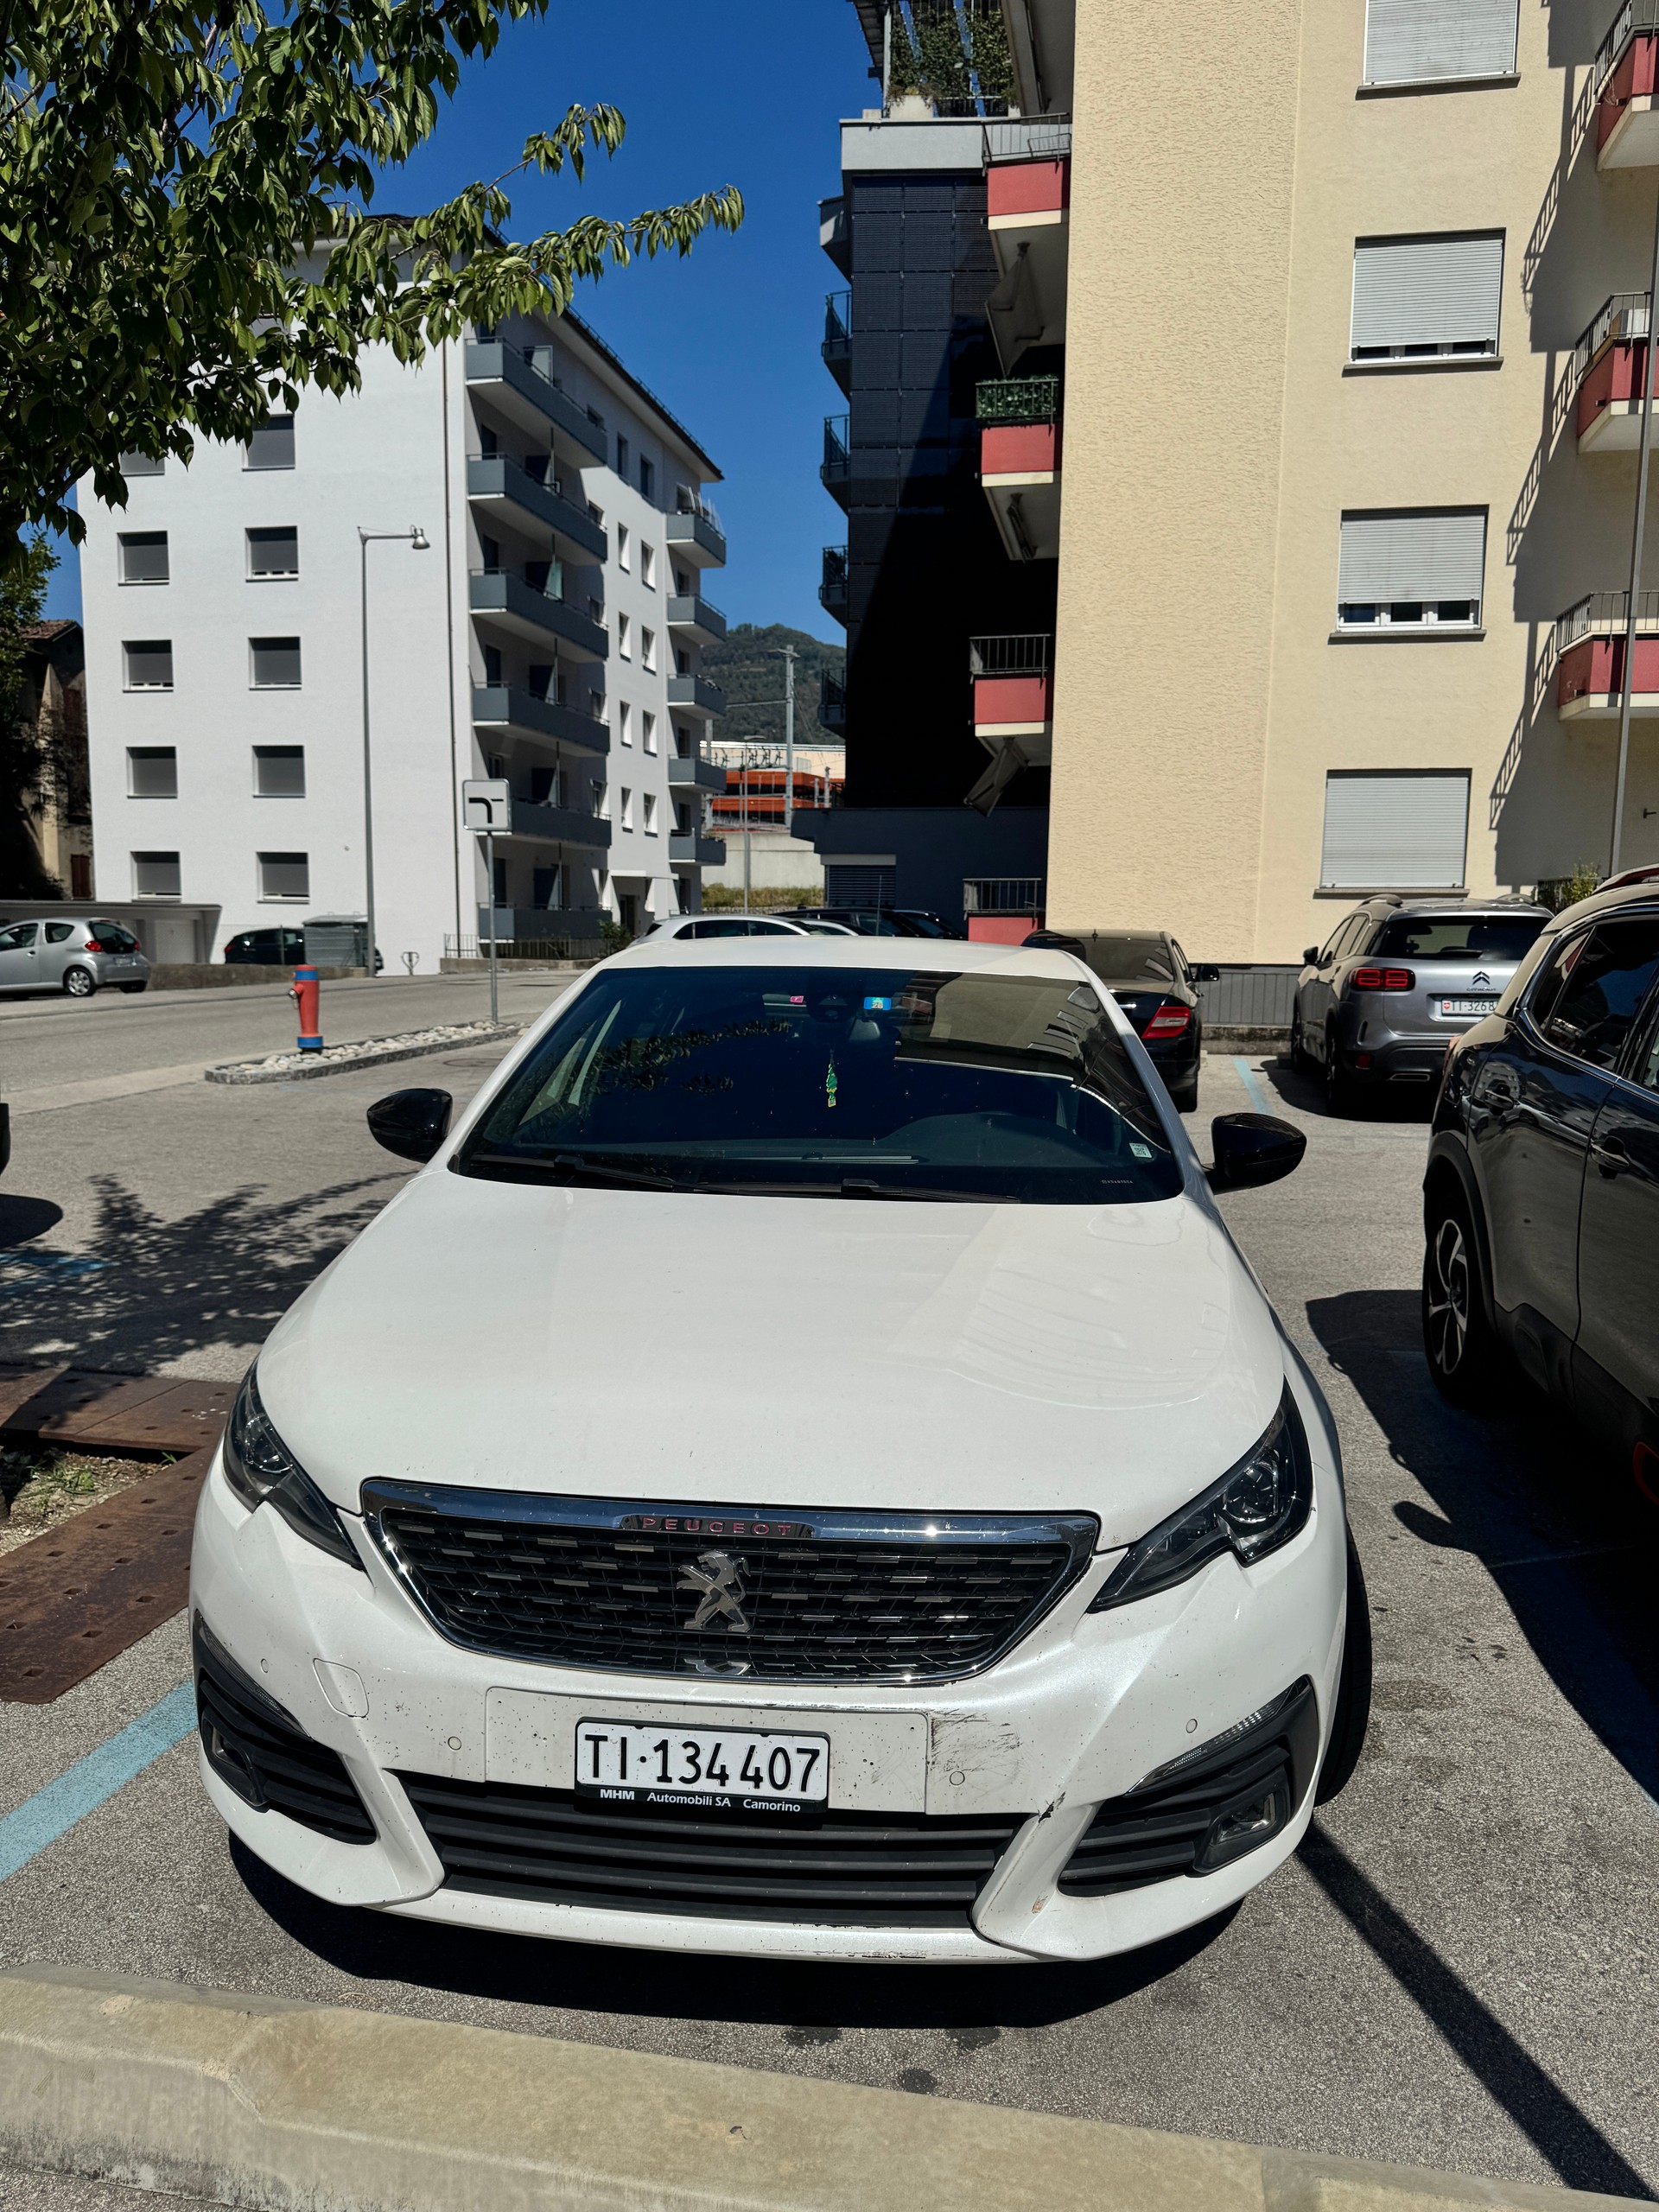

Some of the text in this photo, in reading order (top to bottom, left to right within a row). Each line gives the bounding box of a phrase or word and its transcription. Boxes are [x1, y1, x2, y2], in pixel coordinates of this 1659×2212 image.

[642, 1516, 791, 1536] PEUGEOT
[600, 1788, 801, 1813] MHM Automobili SA Camorino
